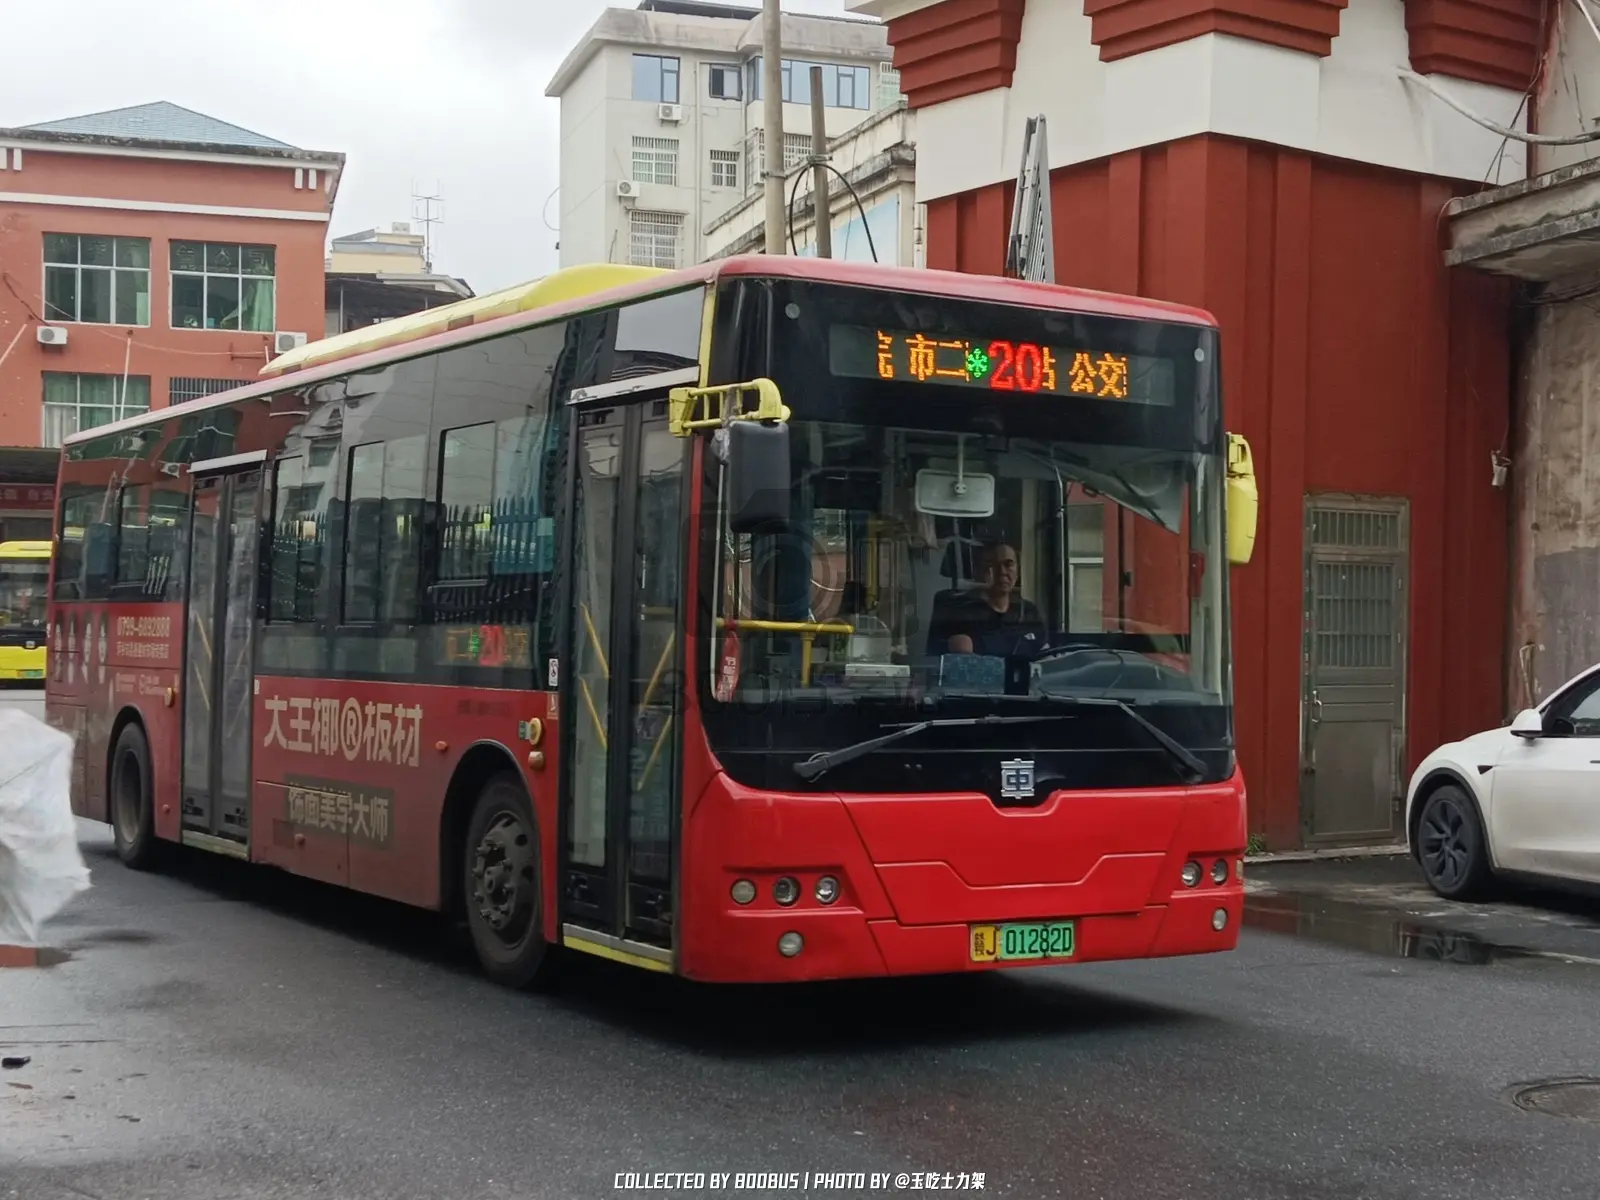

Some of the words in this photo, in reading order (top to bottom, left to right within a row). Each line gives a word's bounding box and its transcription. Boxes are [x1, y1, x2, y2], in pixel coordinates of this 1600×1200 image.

[987, 340, 1042, 392] 20
[1069, 352, 1124, 398] 公交
[1005, 926, 1072, 955] 01282D
